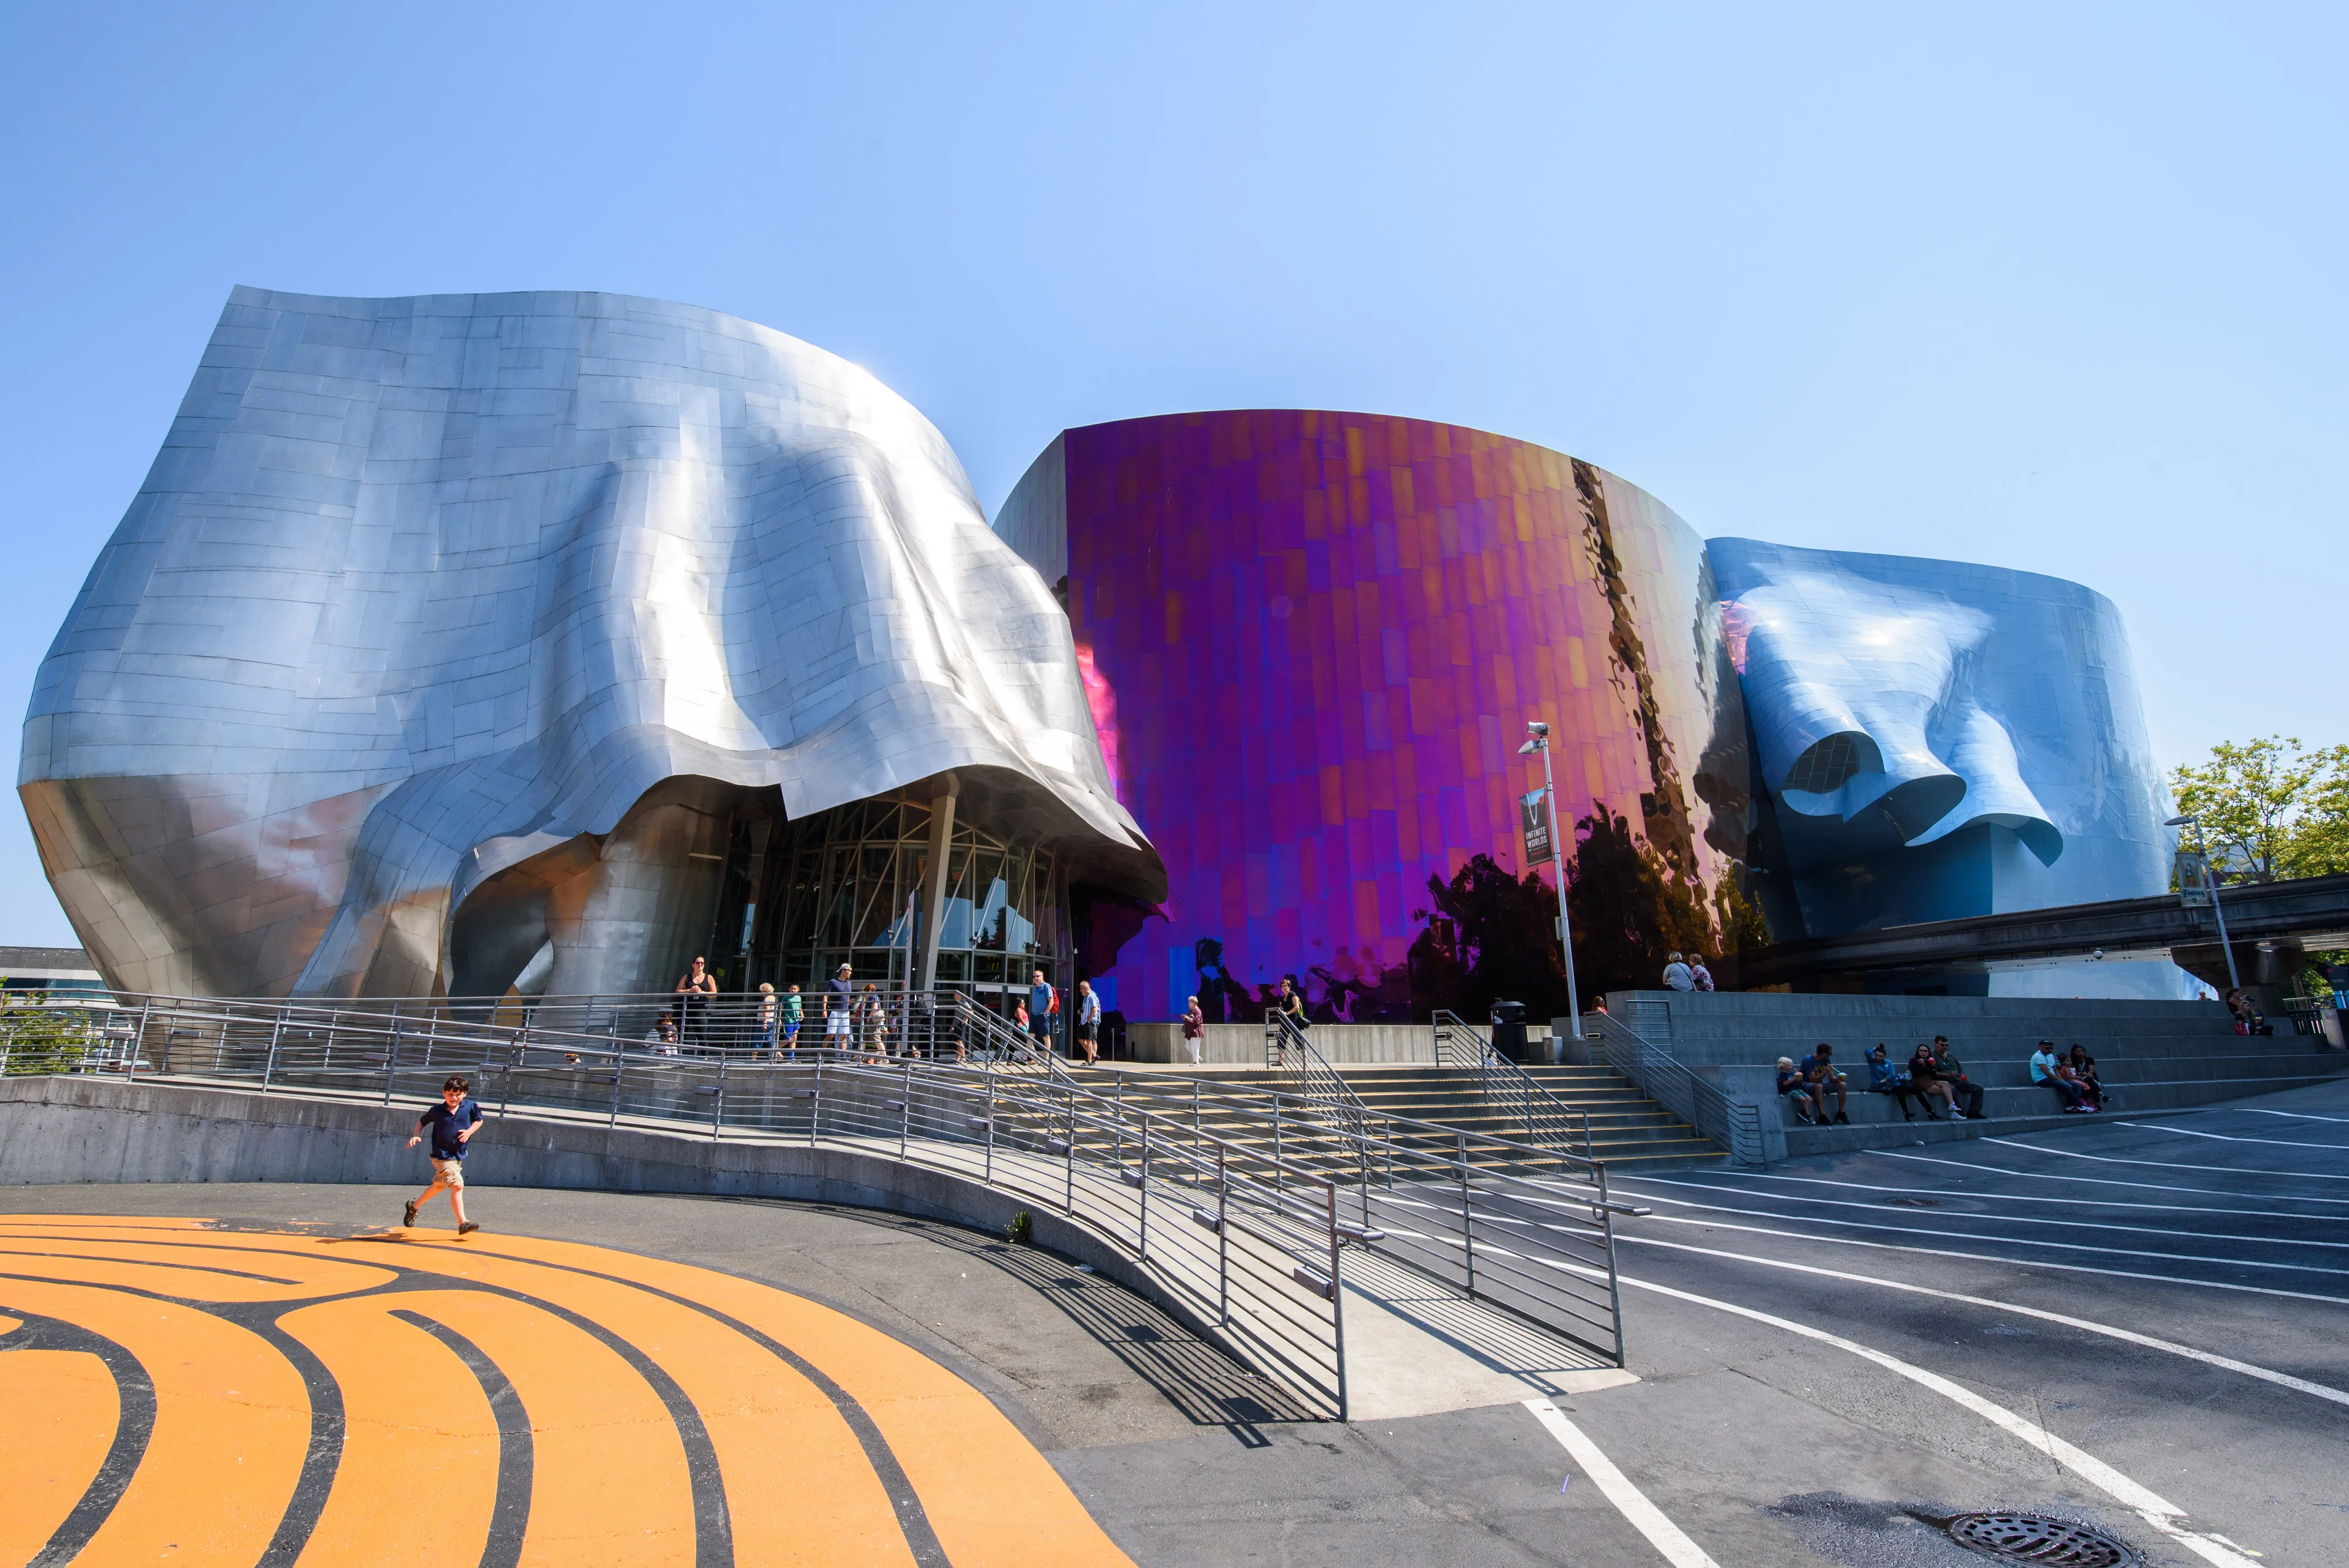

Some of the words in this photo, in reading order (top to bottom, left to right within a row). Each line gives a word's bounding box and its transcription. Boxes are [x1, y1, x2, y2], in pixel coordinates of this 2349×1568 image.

[1526, 826, 1546, 840] INFINITE
[1527, 835, 1547, 849] WORLDS
[2182, 889, 2206, 897] Fantasy
